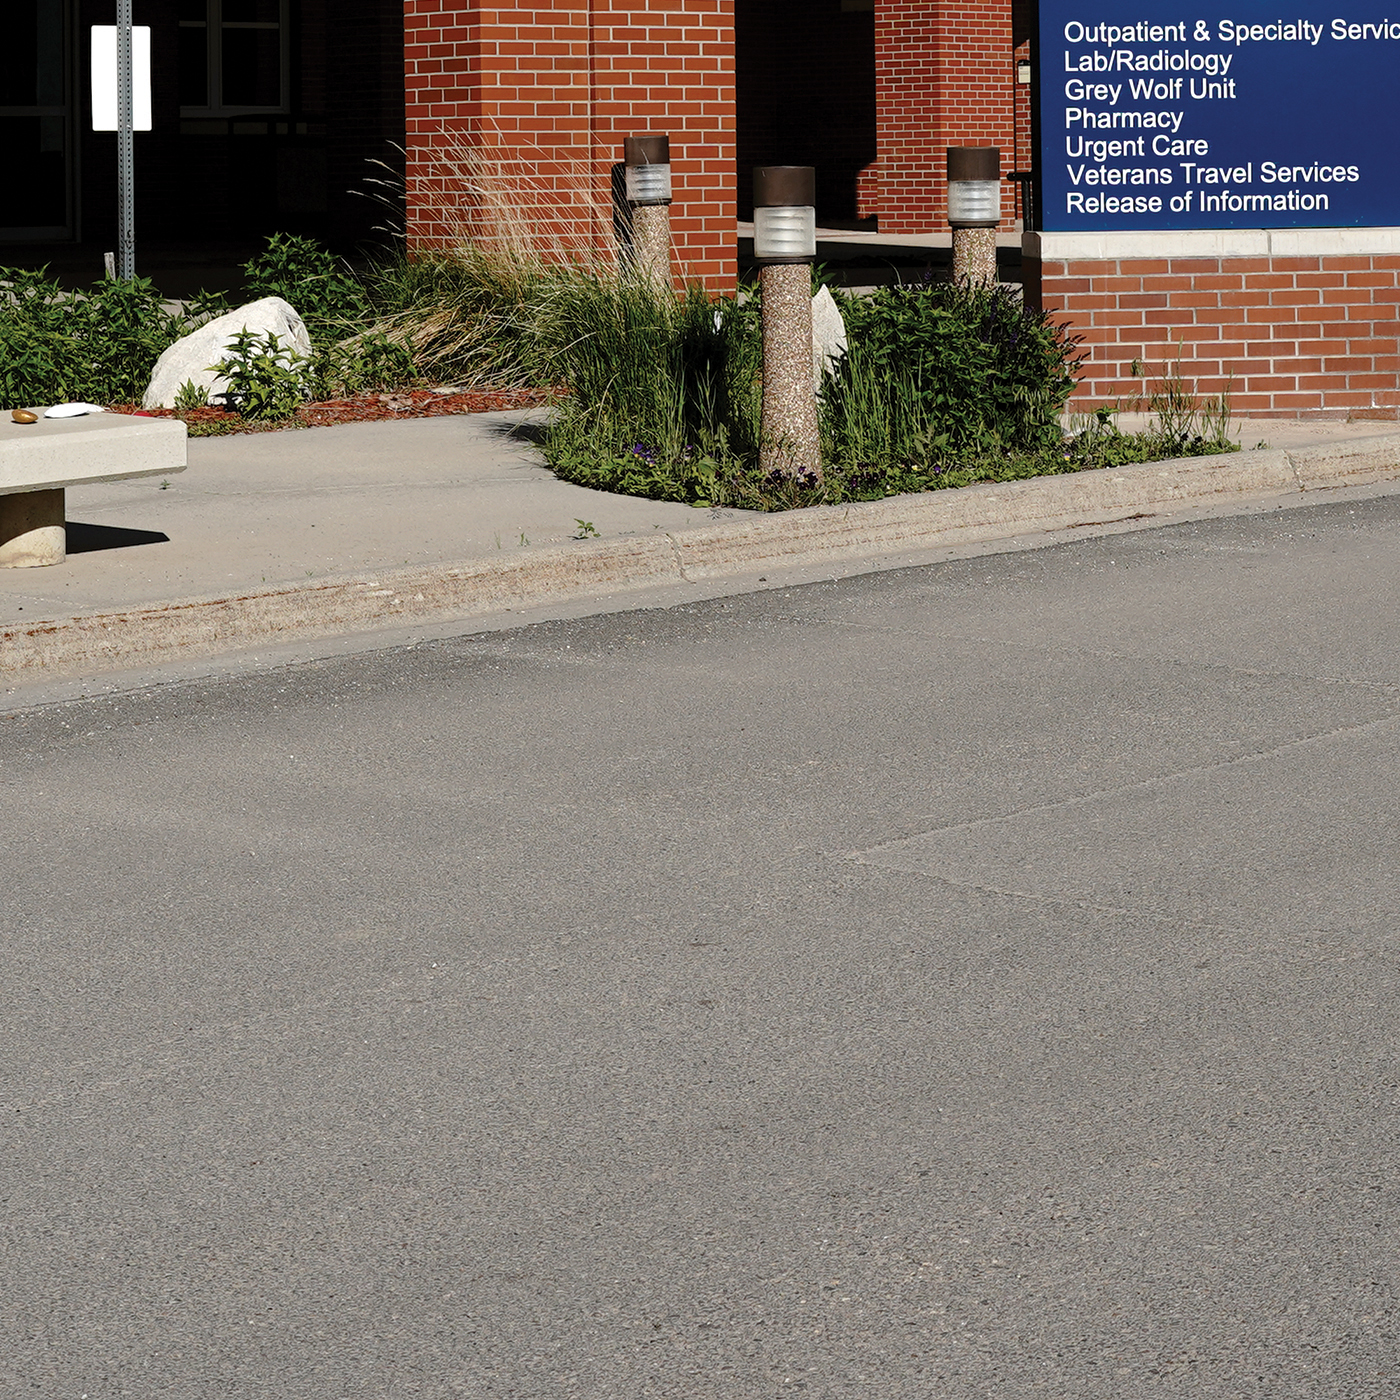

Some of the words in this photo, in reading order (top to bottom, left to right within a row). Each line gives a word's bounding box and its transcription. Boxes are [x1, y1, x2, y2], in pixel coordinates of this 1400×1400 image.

[1064, 20, 1187, 49] Outpatient
[1193, 20, 1211, 42] &
[1218, 18, 1324, 46] Specialty
[1064, 49, 1233, 76] Lab/Radiology
[1064, 79, 1122, 106] Grey
[1129, 78, 1183, 99] Wolf
[1190, 78, 1236, 99] Unit
[1065, 108, 1184, 134] Pharmacy
[1066, 137, 1146, 163] Urgent
[1151, 135, 1209, 157] Care
[1067, 163, 1173, 185] Veterans
[1179, 163, 1252, 185] Travel
[1260, 162, 1360, 184] Services
[1066, 192, 1162, 213] Release
[1169, 191, 1192, 212] of
[1199, 190, 1329, 211] Information
